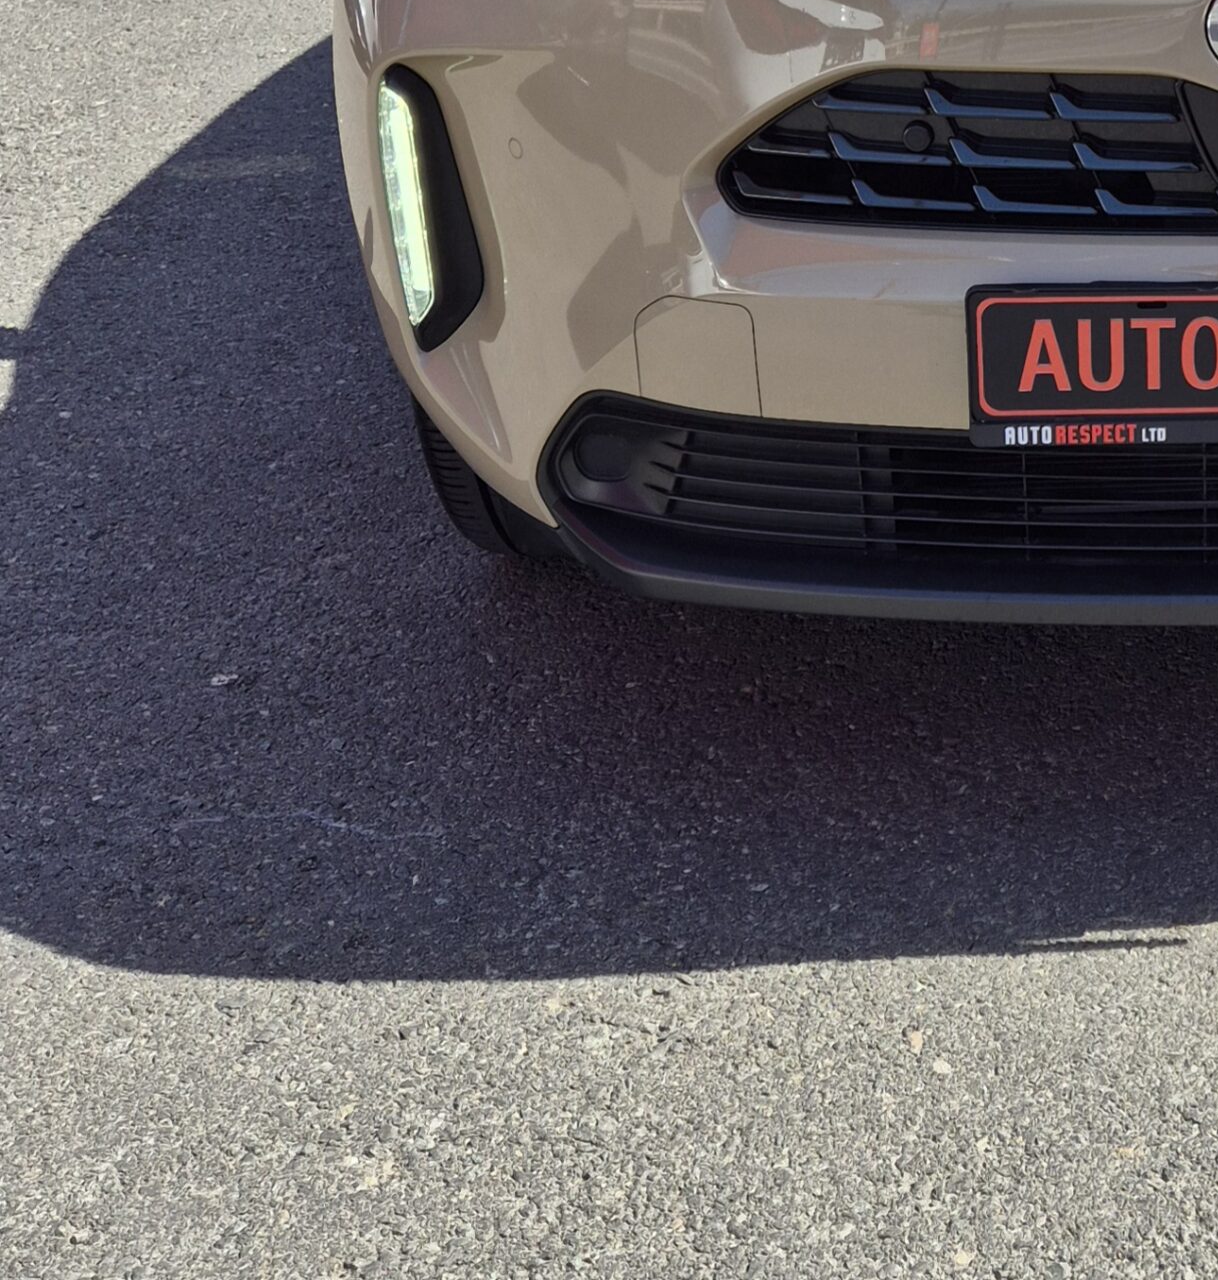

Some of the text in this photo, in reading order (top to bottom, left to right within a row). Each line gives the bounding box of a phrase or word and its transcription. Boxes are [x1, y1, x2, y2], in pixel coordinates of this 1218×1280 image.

[1004, 423, 1167, 446] AUTO RESPECT LTD
